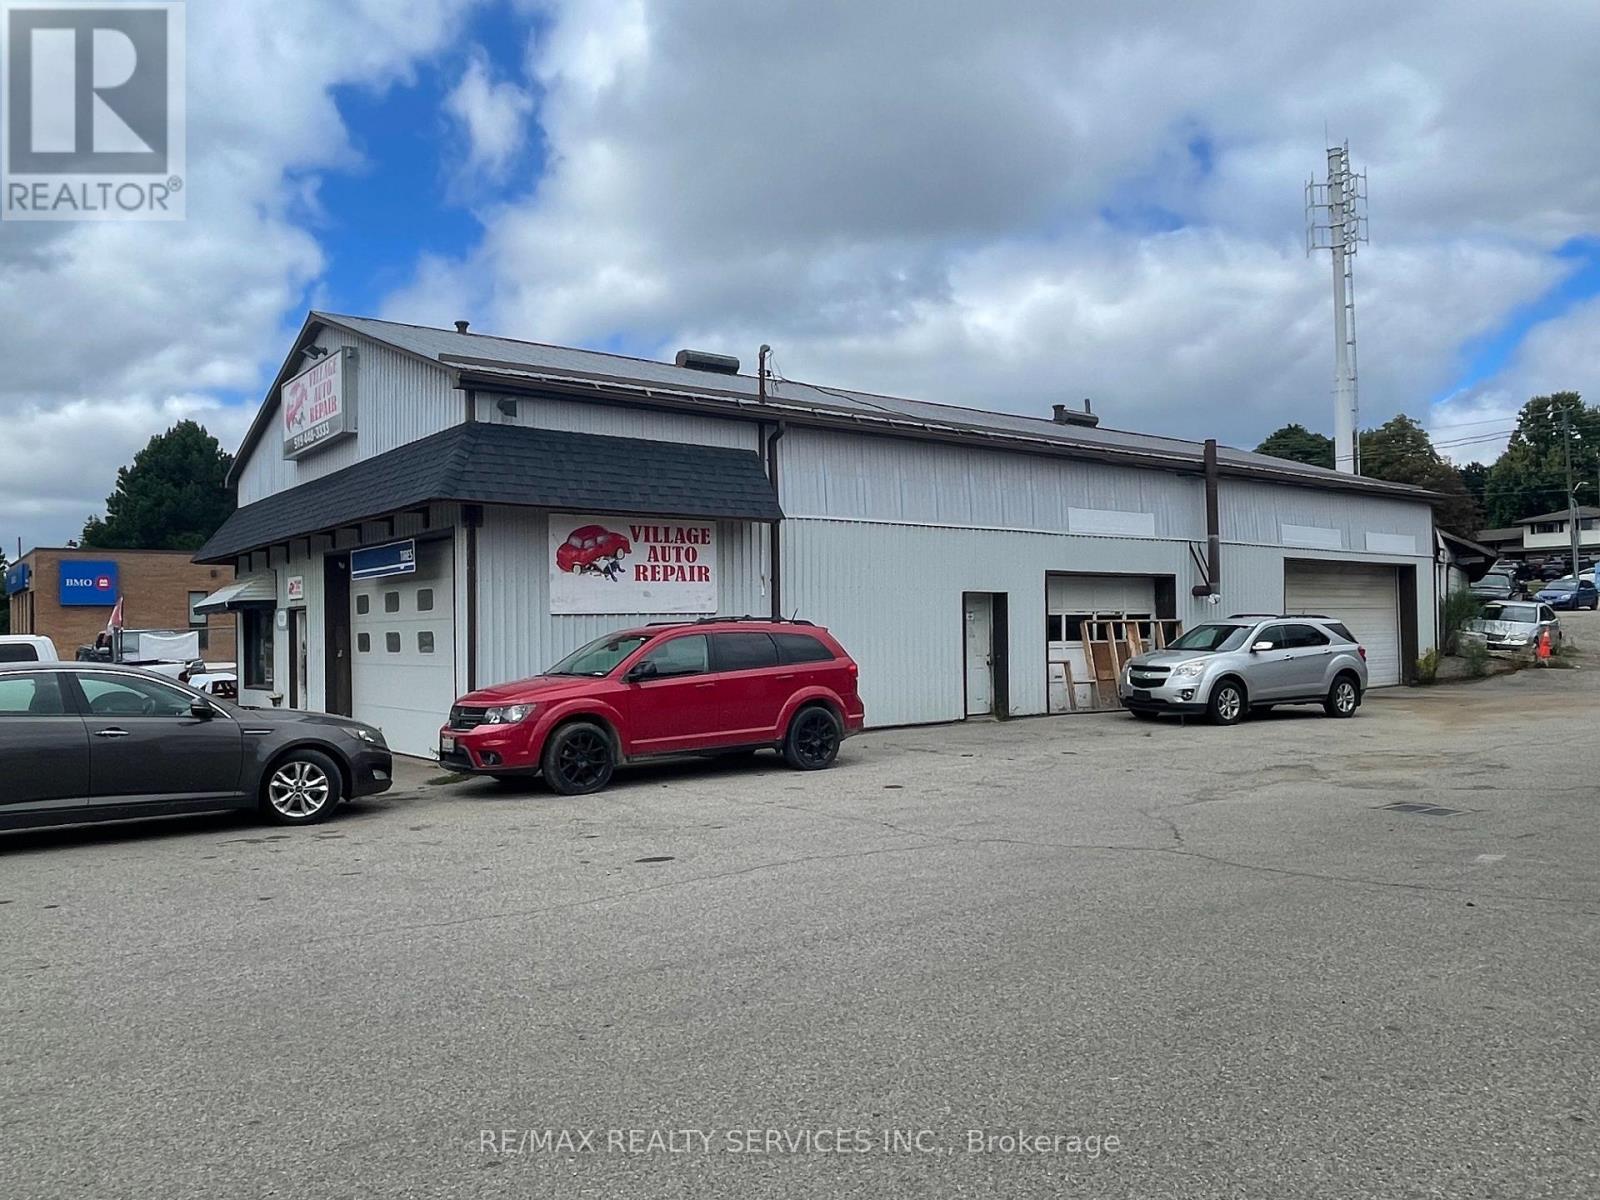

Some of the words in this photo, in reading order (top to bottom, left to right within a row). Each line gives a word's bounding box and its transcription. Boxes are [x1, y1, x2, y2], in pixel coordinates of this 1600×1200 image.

[309, 357, 336, 388] VILLAGE
[314, 379, 332, 401] AUTO
[310, 395, 337, 423] REPAIR
[629, 525, 711, 545] VILLAGE
[647, 546, 698, 563] AUTO
[65, 578, 93, 587] BMO
[634, 564, 710, 582] REPAIR
